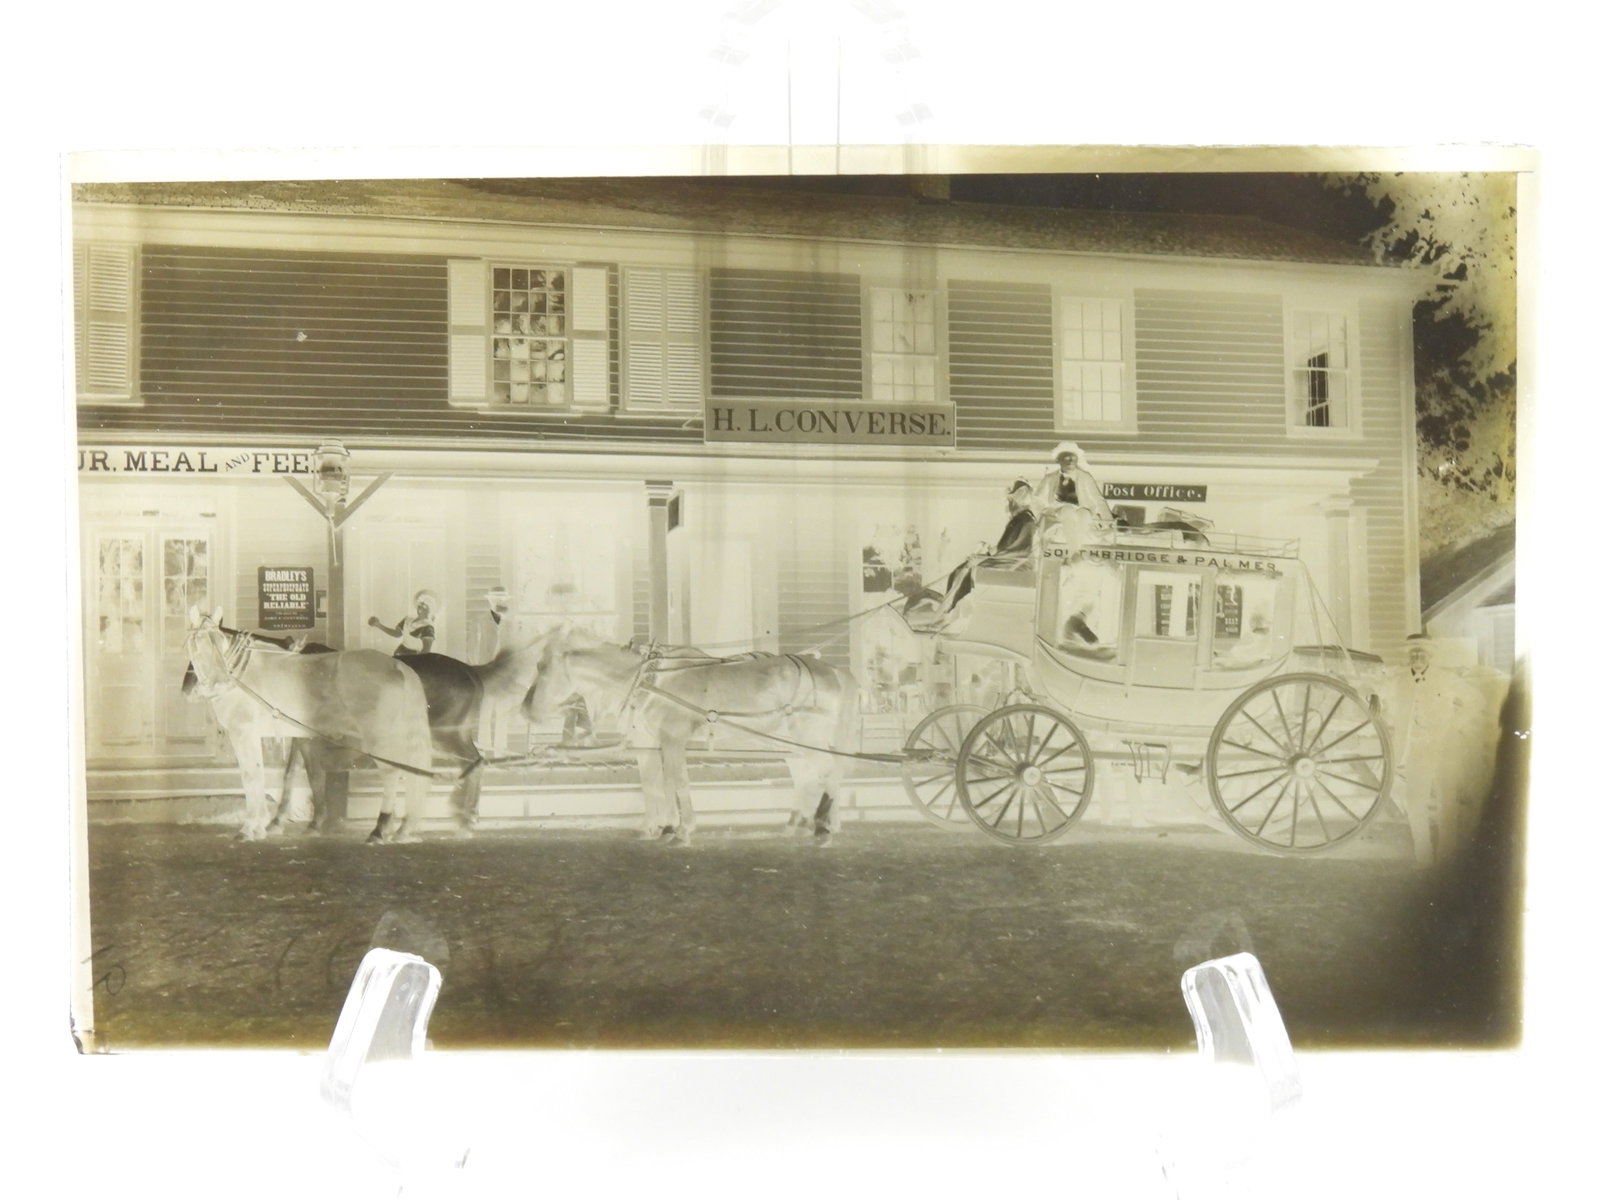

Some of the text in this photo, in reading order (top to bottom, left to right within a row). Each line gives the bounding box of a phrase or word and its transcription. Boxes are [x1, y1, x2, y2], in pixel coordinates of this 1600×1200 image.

[713, 407, 951, 436] H. L. CONVERSE.
[123, 450, 218, 472] MEAL
[225, 452, 249, 472] AND
[1104, 483, 1135, 498] Post
[1177, 555, 1188, 564] &
[290, 593, 306, 601] OLD
